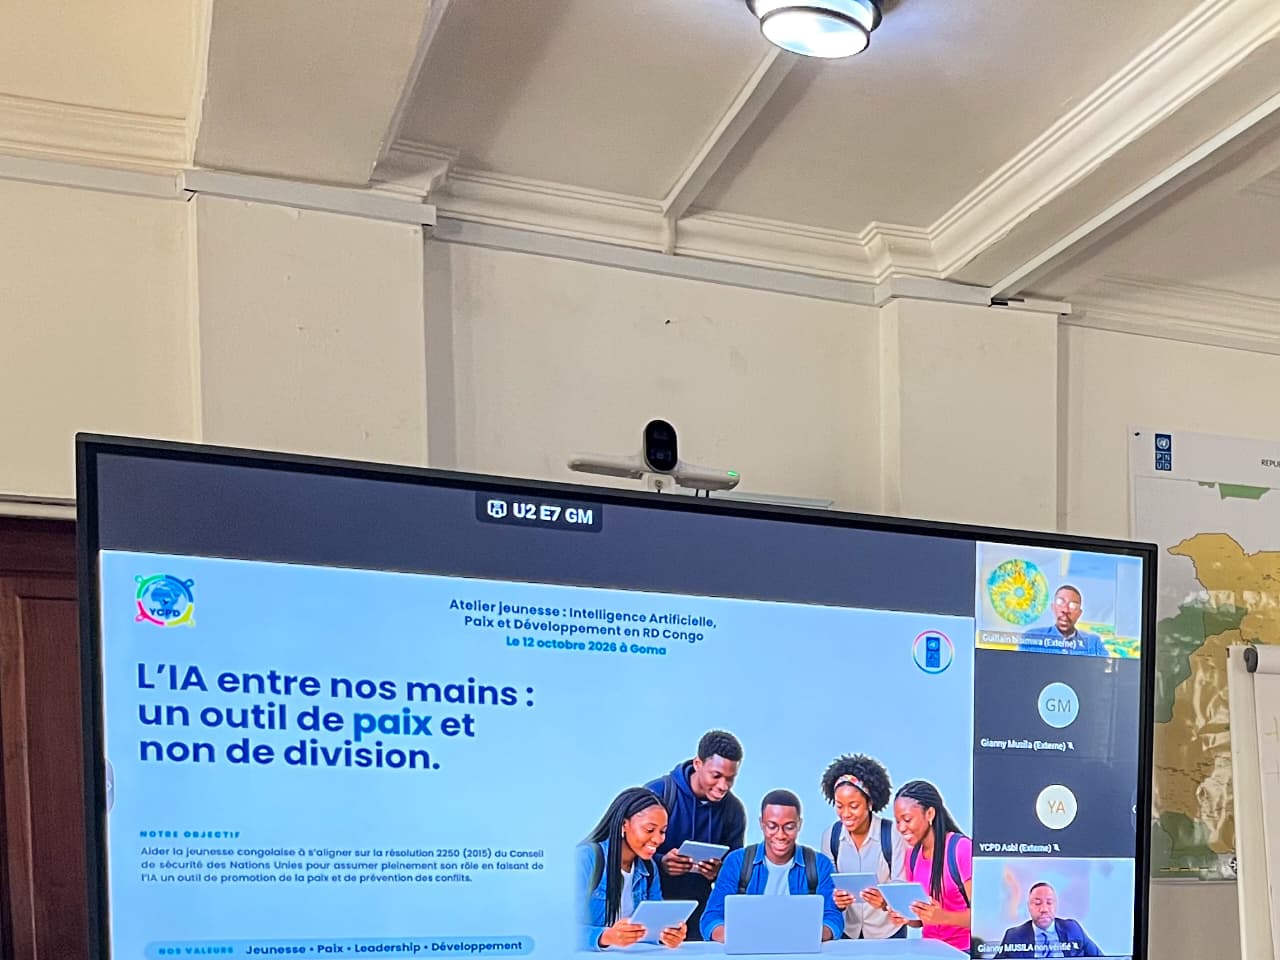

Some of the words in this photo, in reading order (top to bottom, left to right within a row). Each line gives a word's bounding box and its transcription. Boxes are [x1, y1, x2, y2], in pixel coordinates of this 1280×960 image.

[513, 502, 537, 519] U2
[540, 506, 561, 521] E7
[565, 508, 593, 525] GM
[149, 607, 181, 617] YCPD
[449, 599, 496, 612] Atelier
[498, 600, 560, 616] jeunesse
[569, 607, 647, 623] Intelligence
[649, 613, 717, 629] Artificielle,
[464, 615, 495, 628] Paix
[497, 618, 511, 629] et
[513, 618, 622, 636] Développement
[624, 629, 640, 637] en
[643, 628, 660, 638] RD
[662, 629, 704, 643] Congo
[506, 635, 520, 646] Le
[522, 636, 535, 647] 12
[536, 638, 586, 651] octobre
[619, 642, 628, 653] à
[630, 643, 667, 655] Goma
[1043, 638, 1077, 649] (Externe)
[217, 670, 322, 697] entre
[330, 676, 397, 701] nos
[406, 677, 518, 706] mains
[1045, 697, 1072, 713] GM
[138, 703, 190, 727] un
[200, 703, 288, 731] outil
[296, 704, 345, 734] de
[353, 707, 433, 743] paix
[439, 713, 476, 738] et
[1033, 741, 1067, 751] (Externe)
[139, 738, 216, 764] non
[225, 738, 276, 766] de
[283, 738, 441, 771] division.
[1048, 800, 1066, 814] YA
[140, 830, 178, 838] NOTRE
[184, 831, 240, 839] OBJECTIF
[141, 847, 170, 856] Aider
[173, 847, 183, 856] la
[185, 847, 234, 858] jeunesse
[237, 847, 296, 859] congolaise
[298, 847, 306, 856] à
[373, 849, 383, 857] la
[385, 848, 434, 857] résolution
[436, 849, 460, 857] 2250
[463, 848, 492, 859] (2015)
[494, 849, 508, 858] du
[509, 849, 544, 858] Conseil
[979, 843, 1001, 852] YCPD
[1018, 843, 1052, 853] (Externe)
[141, 860, 155, 869] de
[159, 860, 203, 869] sécurité
[206, 860, 226, 869] des
[230, 860, 270, 869] Nations
[274, 860, 303, 870] Unies
[306, 862, 330, 871] pour
[381, 861, 437, 871] pleinement
[460, 861, 478, 870] rôle
[496, 861, 529, 870] faisant
[531, 861, 544, 870] de
[177, 873, 201, 882] outil
[203, 874, 217, 882] de
[220, 874, 276, 884] promotion
[278, 874, 292, 882] de
[294, 874, 305, 882] la
[307, 874, 329, 884] paix
[331, 874, 341, 882] et
[343, 874, 357, 882] de
[359, 873, 413, 884] prévention
[414, 874, 433, 882] des
[435, 873, 472, 882] conflits.
[158, 947, 181, 955] NOS
[185, 946, 234, 955] VALEURS
[246, 945, 306, 955] Jeunesse
[317, 944, 343, 953] Paix
[354, 942, 421, 954] Leadership
[431, 941, 523, 953] Développement
[1004, 943, 1034, 952] MUSILA
